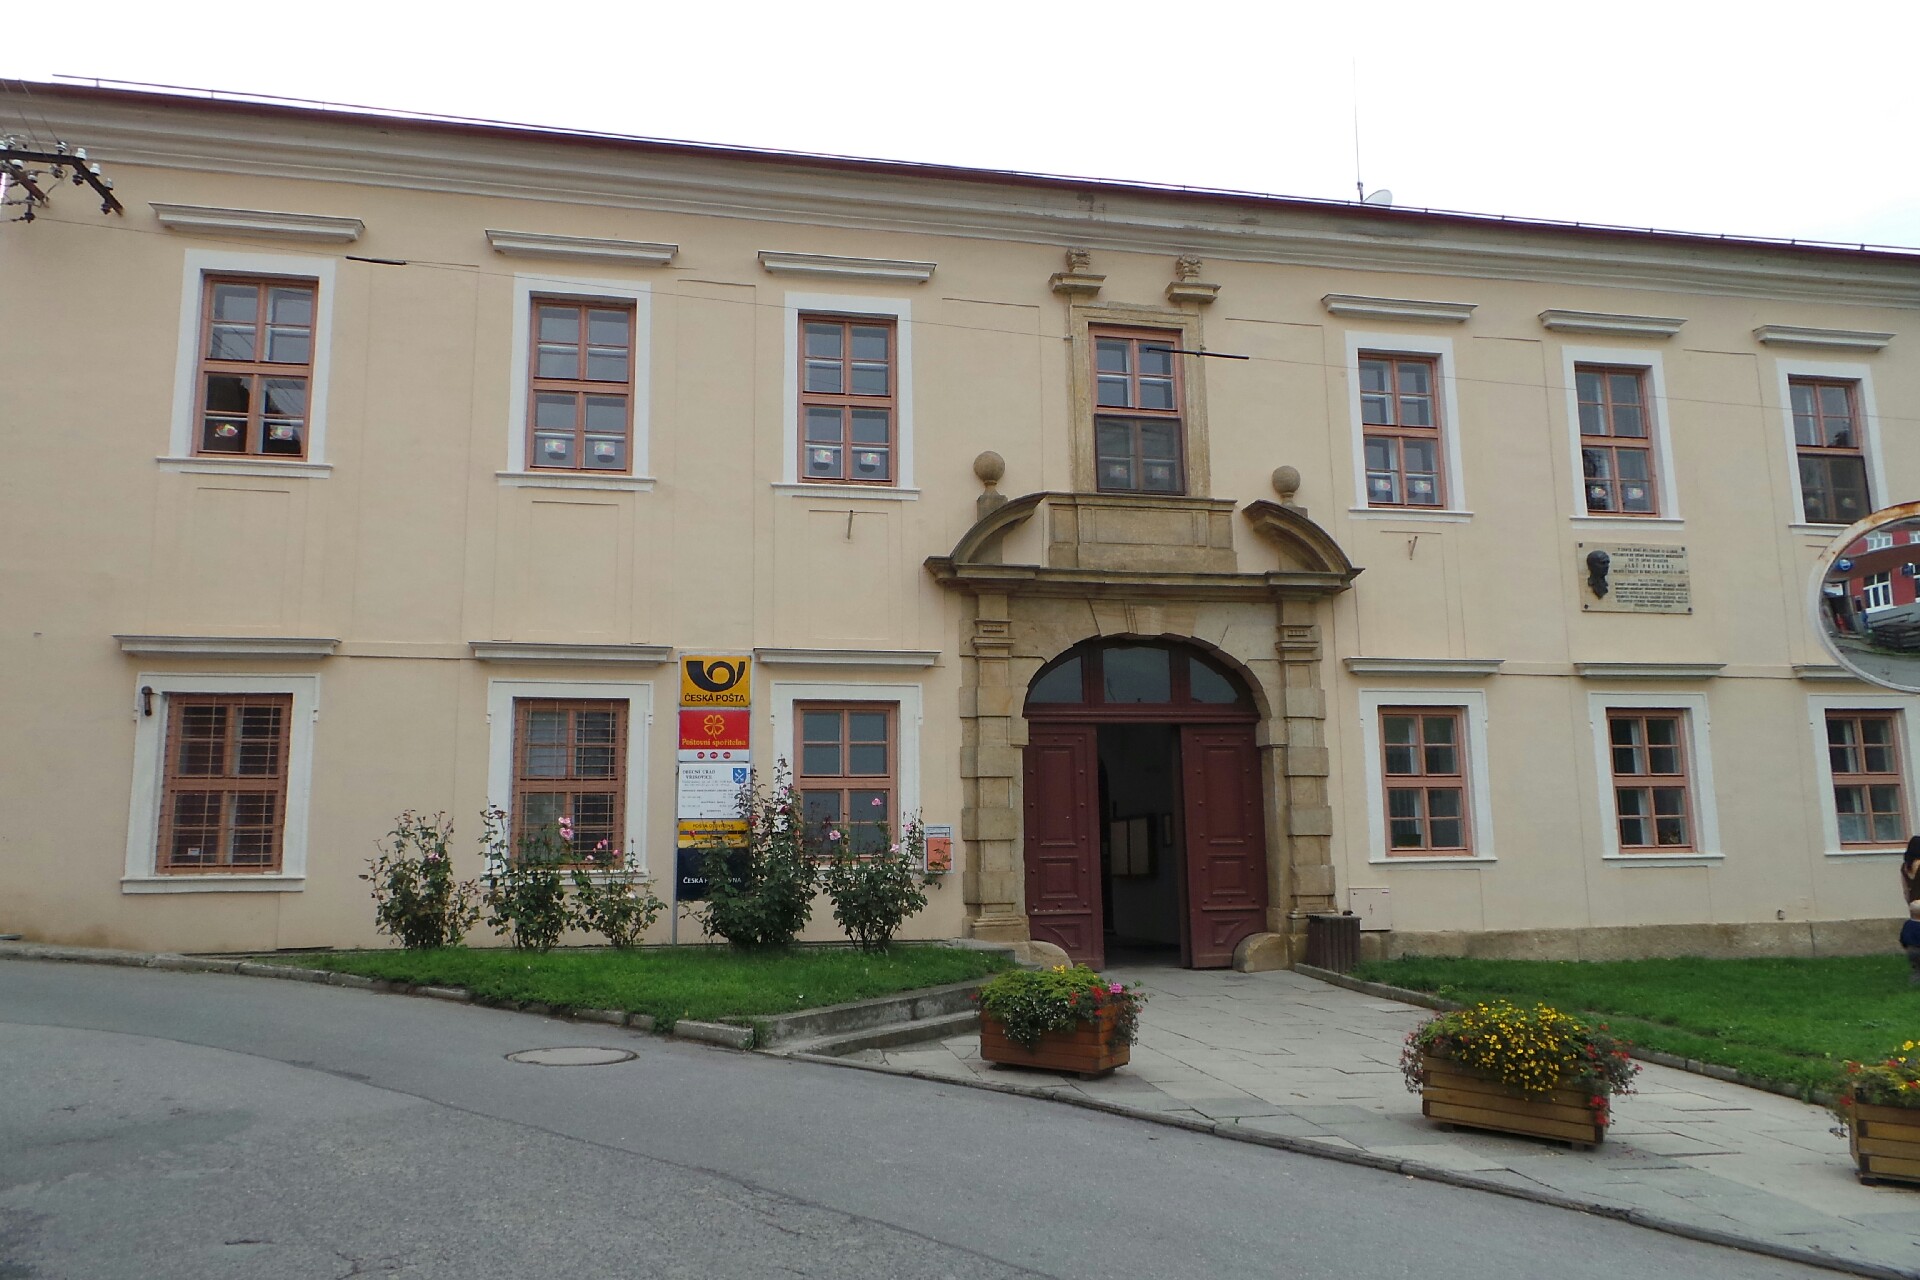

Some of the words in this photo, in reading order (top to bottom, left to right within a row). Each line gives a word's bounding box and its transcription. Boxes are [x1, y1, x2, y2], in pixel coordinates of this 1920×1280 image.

[684, 693, 714, 702] ČESKÁ
[716, 693, 745, 702] POŠTA
[682, 738, 711, 746] Poštovní
[682, 876, 704, 884] ČESKÁ
